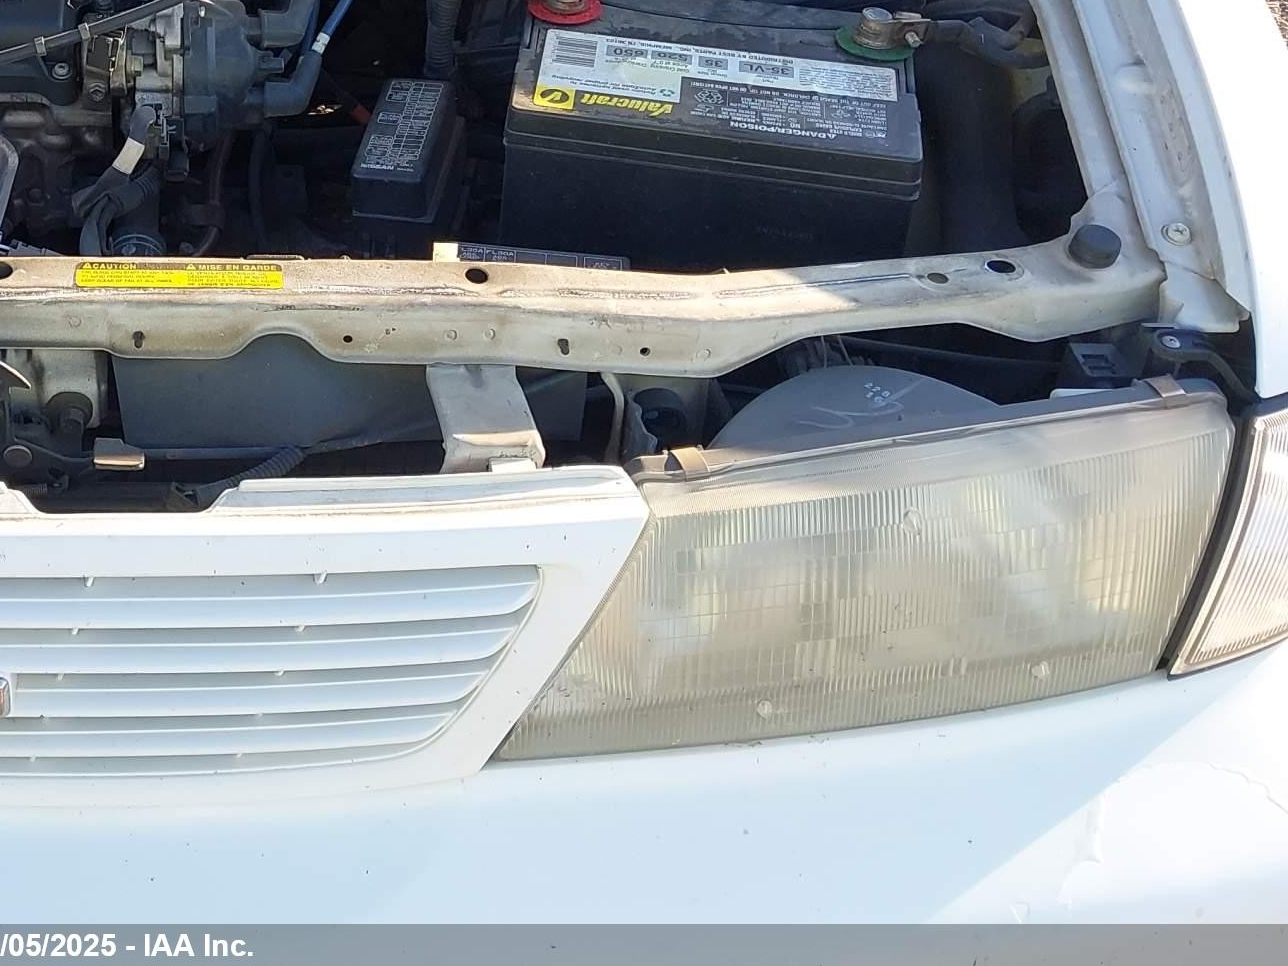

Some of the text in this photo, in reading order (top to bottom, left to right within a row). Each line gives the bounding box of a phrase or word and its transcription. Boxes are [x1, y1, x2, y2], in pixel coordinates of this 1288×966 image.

[613, 47, 644, 58] 650
[656, 51, 687, 61] 520
[704, 58, 723, 67] 35
[742, 63, 789, 75] 35-VL
[580, 93, 674, 117] Valucraft
[729, 120, 827, 138] DANGER/POISON
